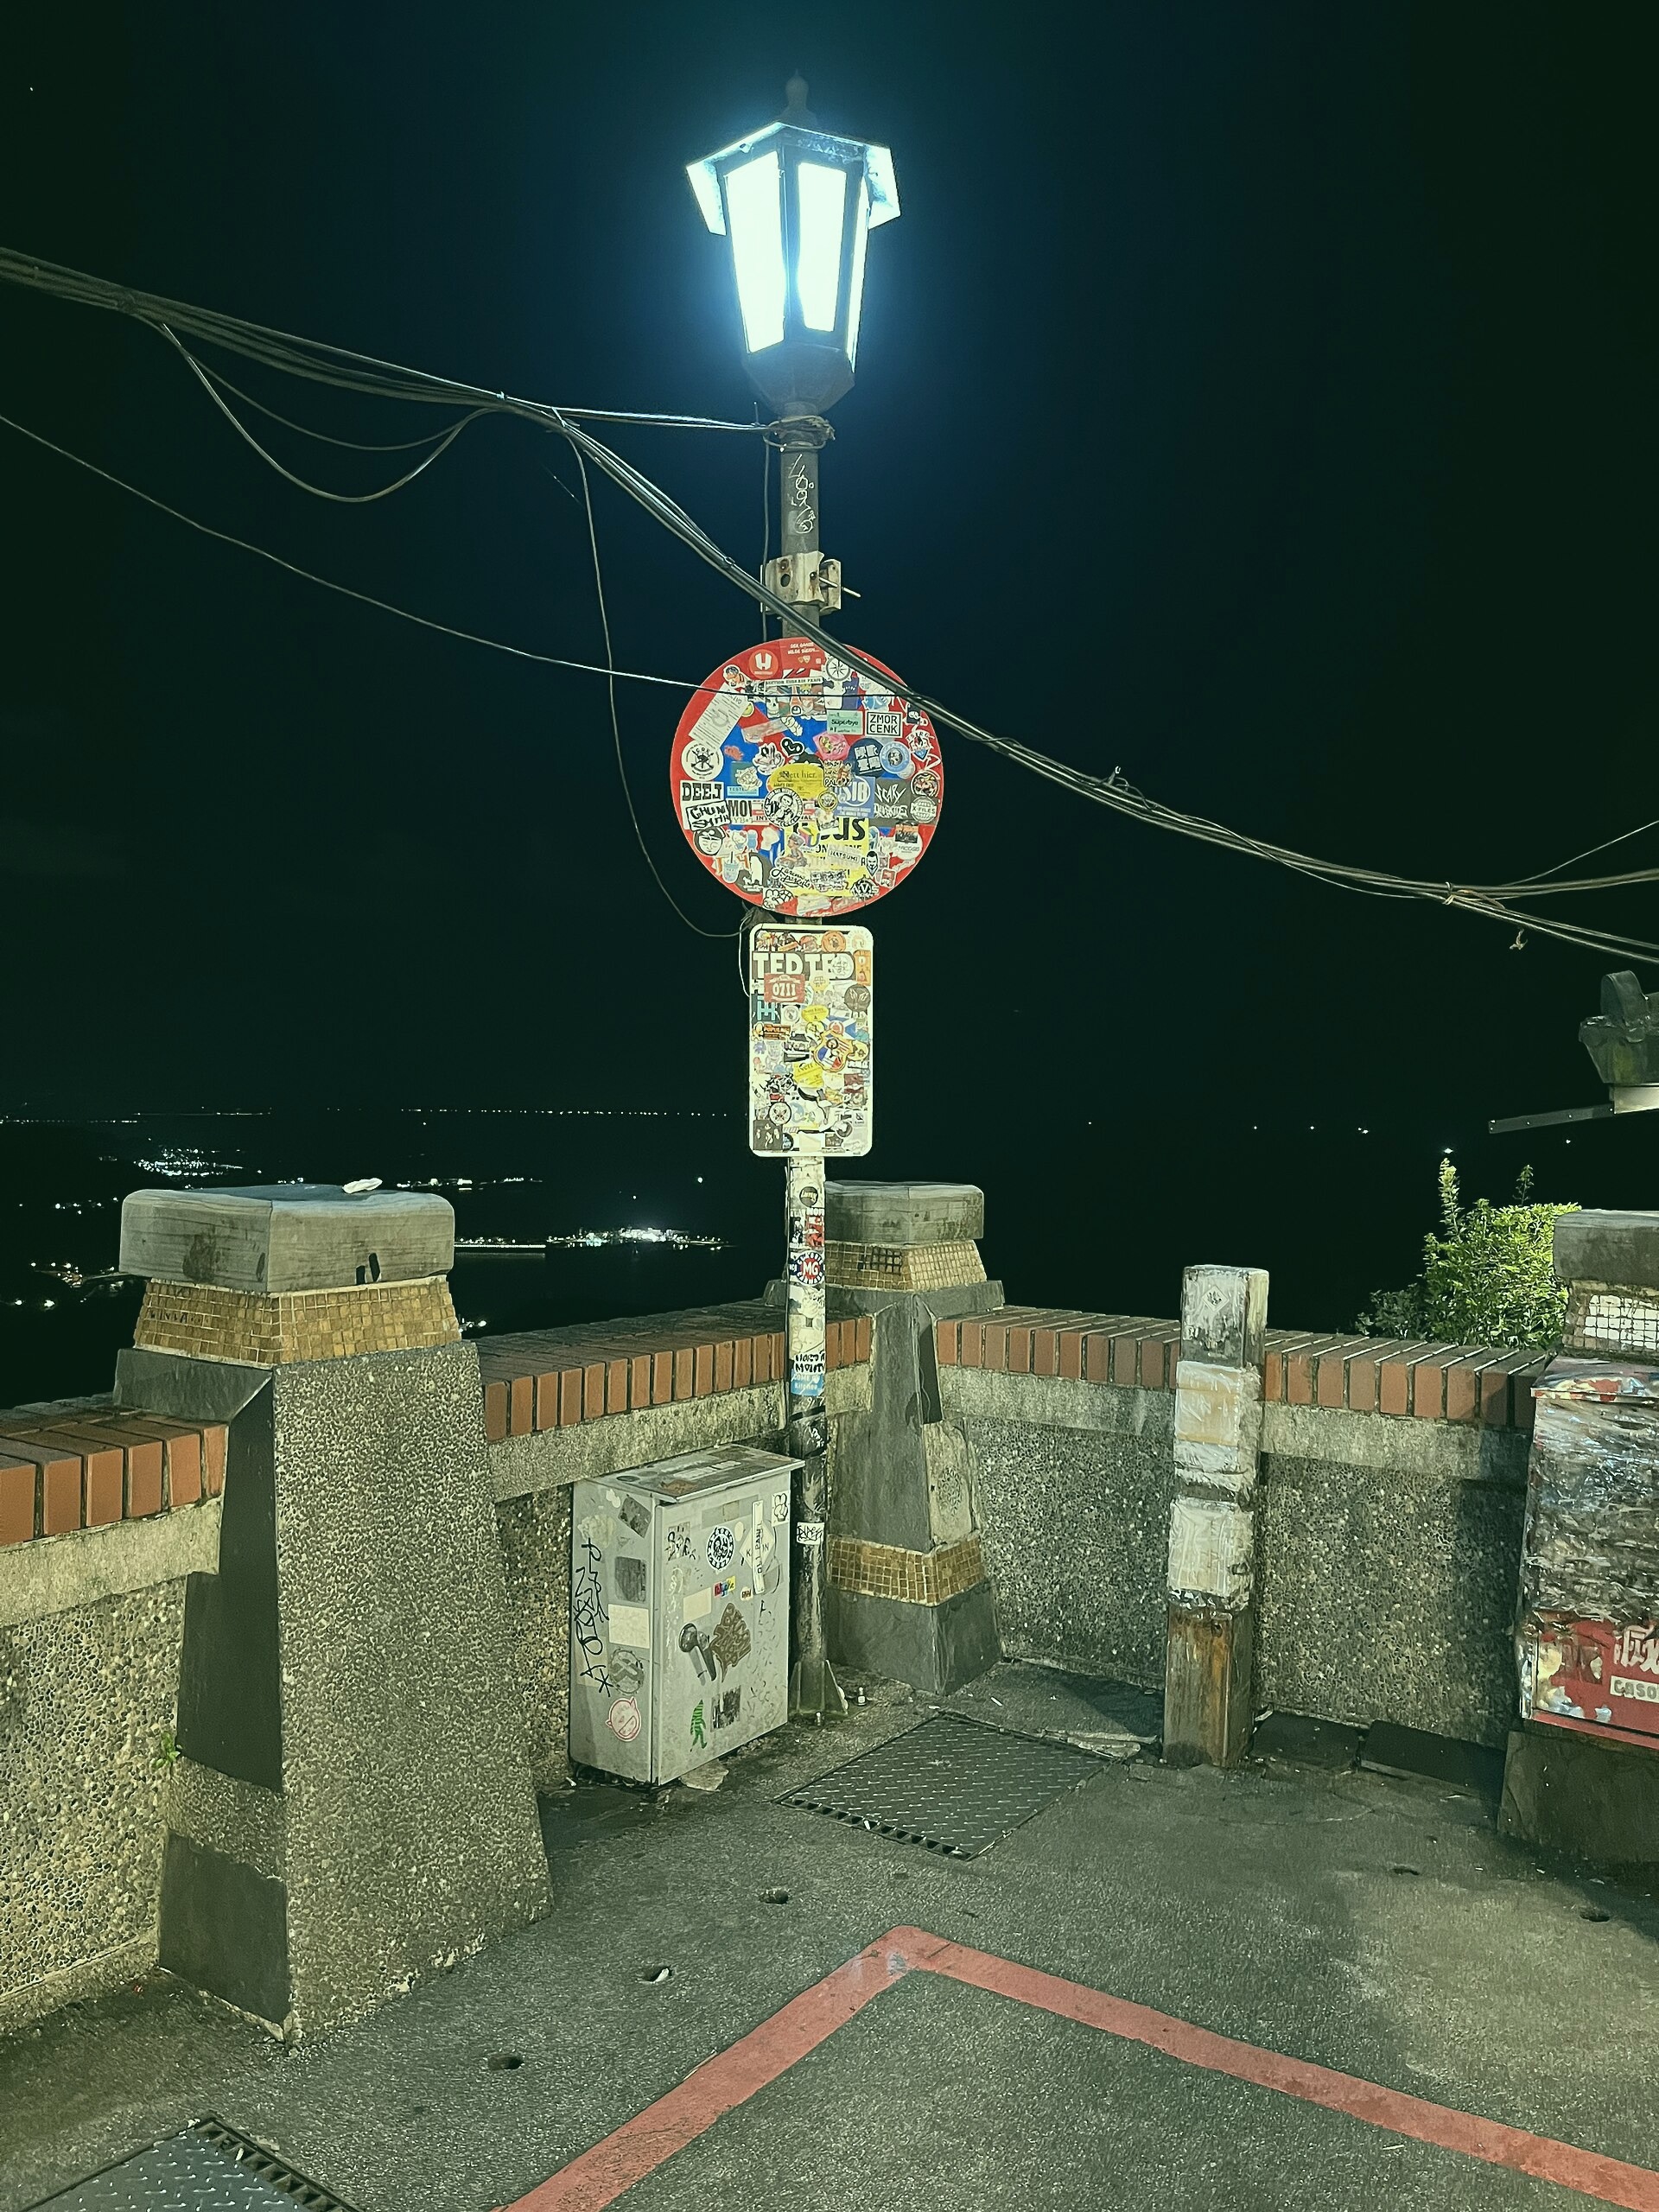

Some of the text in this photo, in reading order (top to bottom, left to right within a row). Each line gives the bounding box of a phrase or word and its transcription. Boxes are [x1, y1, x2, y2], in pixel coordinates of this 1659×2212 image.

[869, 715, 898, 724] ZMOR
[869, 724, 898, 734] CENK
[682, 782, 722, 801] DEEJ
[753, 953, 804, 979] TED
[772, 983, 796, 996] 0711
[803, 1261, 819, 1276] MG
